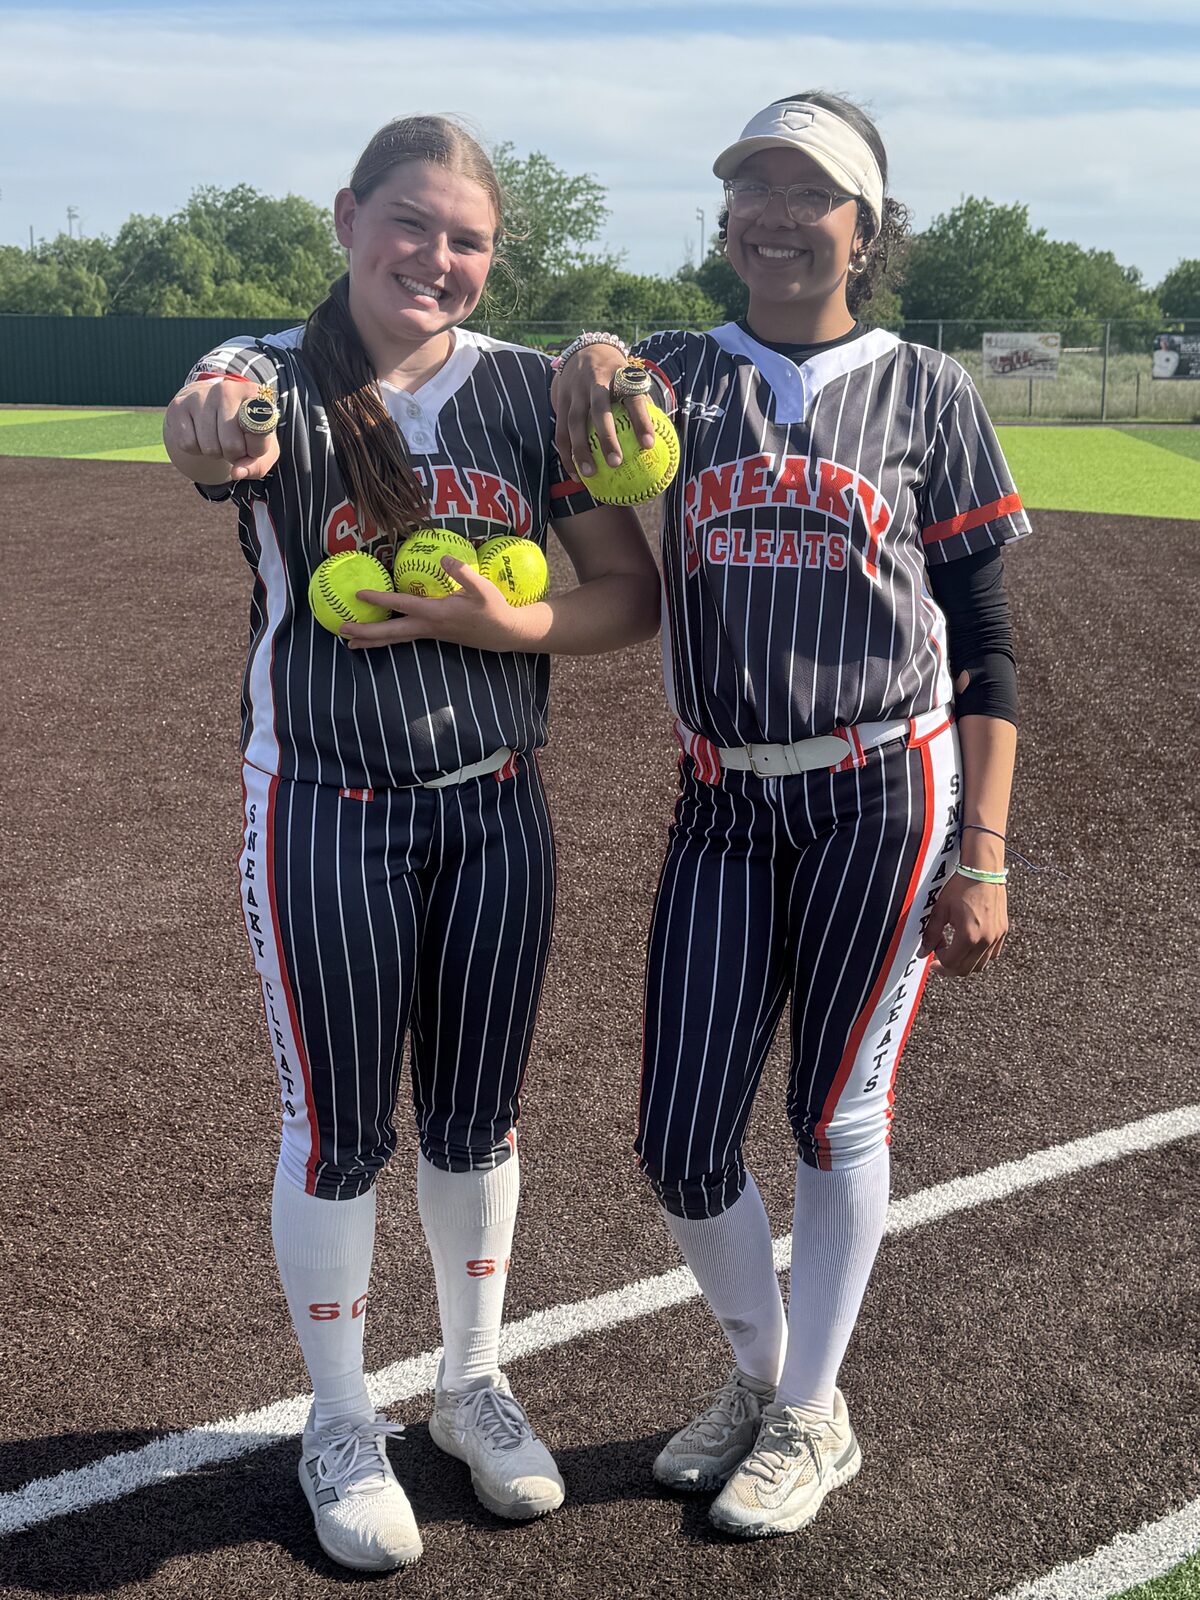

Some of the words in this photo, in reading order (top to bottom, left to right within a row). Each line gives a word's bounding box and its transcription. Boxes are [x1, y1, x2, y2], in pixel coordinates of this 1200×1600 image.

[247, 406, 273, 415] NCS
[323, 465, 533, 557] SAKY
[502, 555, 516, 593] DUDLEY
[707, 528, 848, 571] CLEATS
[244, 803, 265, 958] SNEAKY
[265, 981, 297, 1118] CLEATS
[862, 958, 917, 1094] CLEATS
[466, 1258, 510, 1278] S
